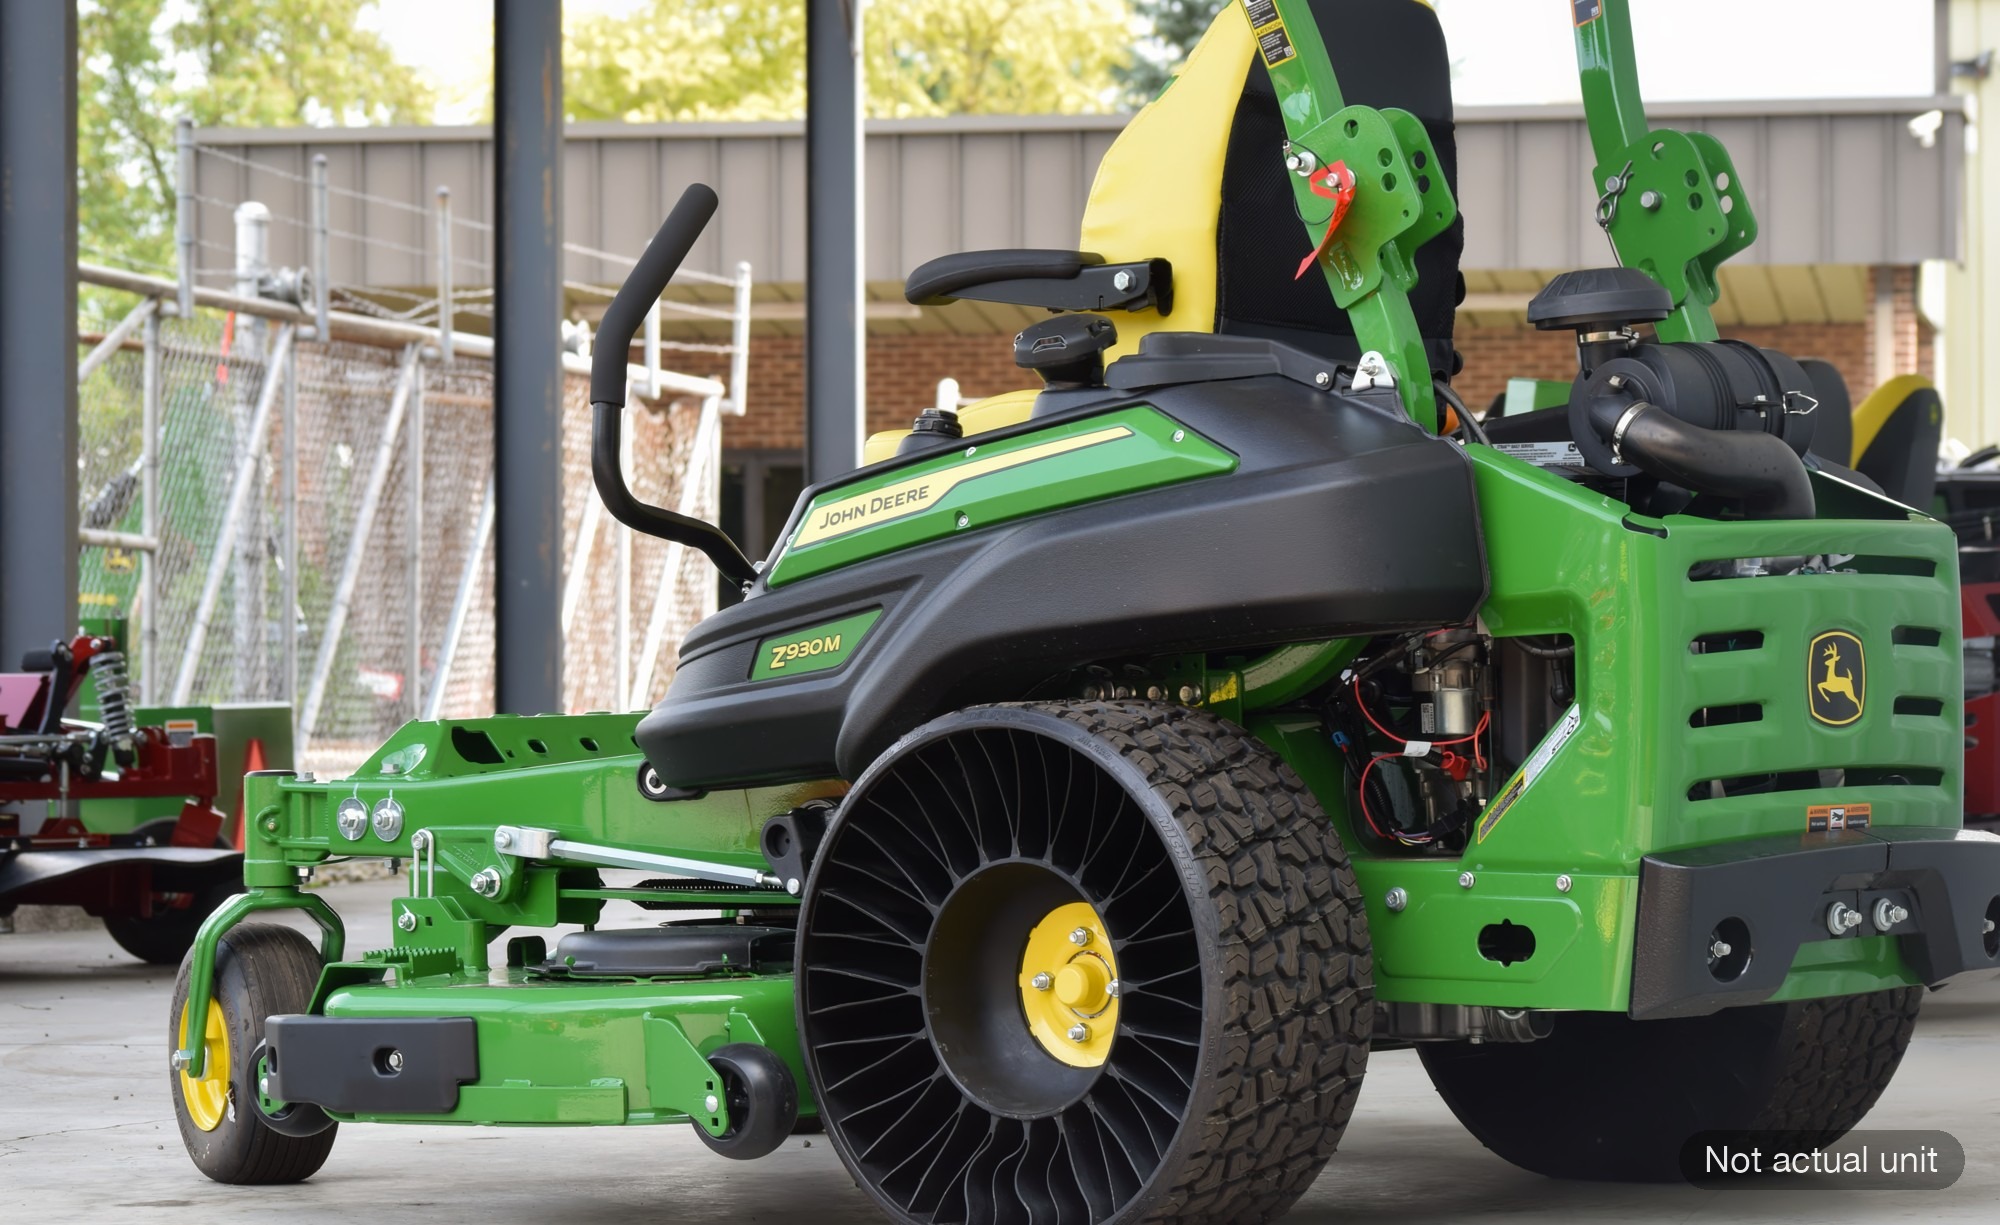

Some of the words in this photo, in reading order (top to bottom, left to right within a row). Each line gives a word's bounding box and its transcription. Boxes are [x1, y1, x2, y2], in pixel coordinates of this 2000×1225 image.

[819, 504, 866, 530] JOHN
[870, 485, 929, 514] DEERE
[770, 634, 841, 669] Z930M
[1158, 815, 1204, 899] MICHELIN
